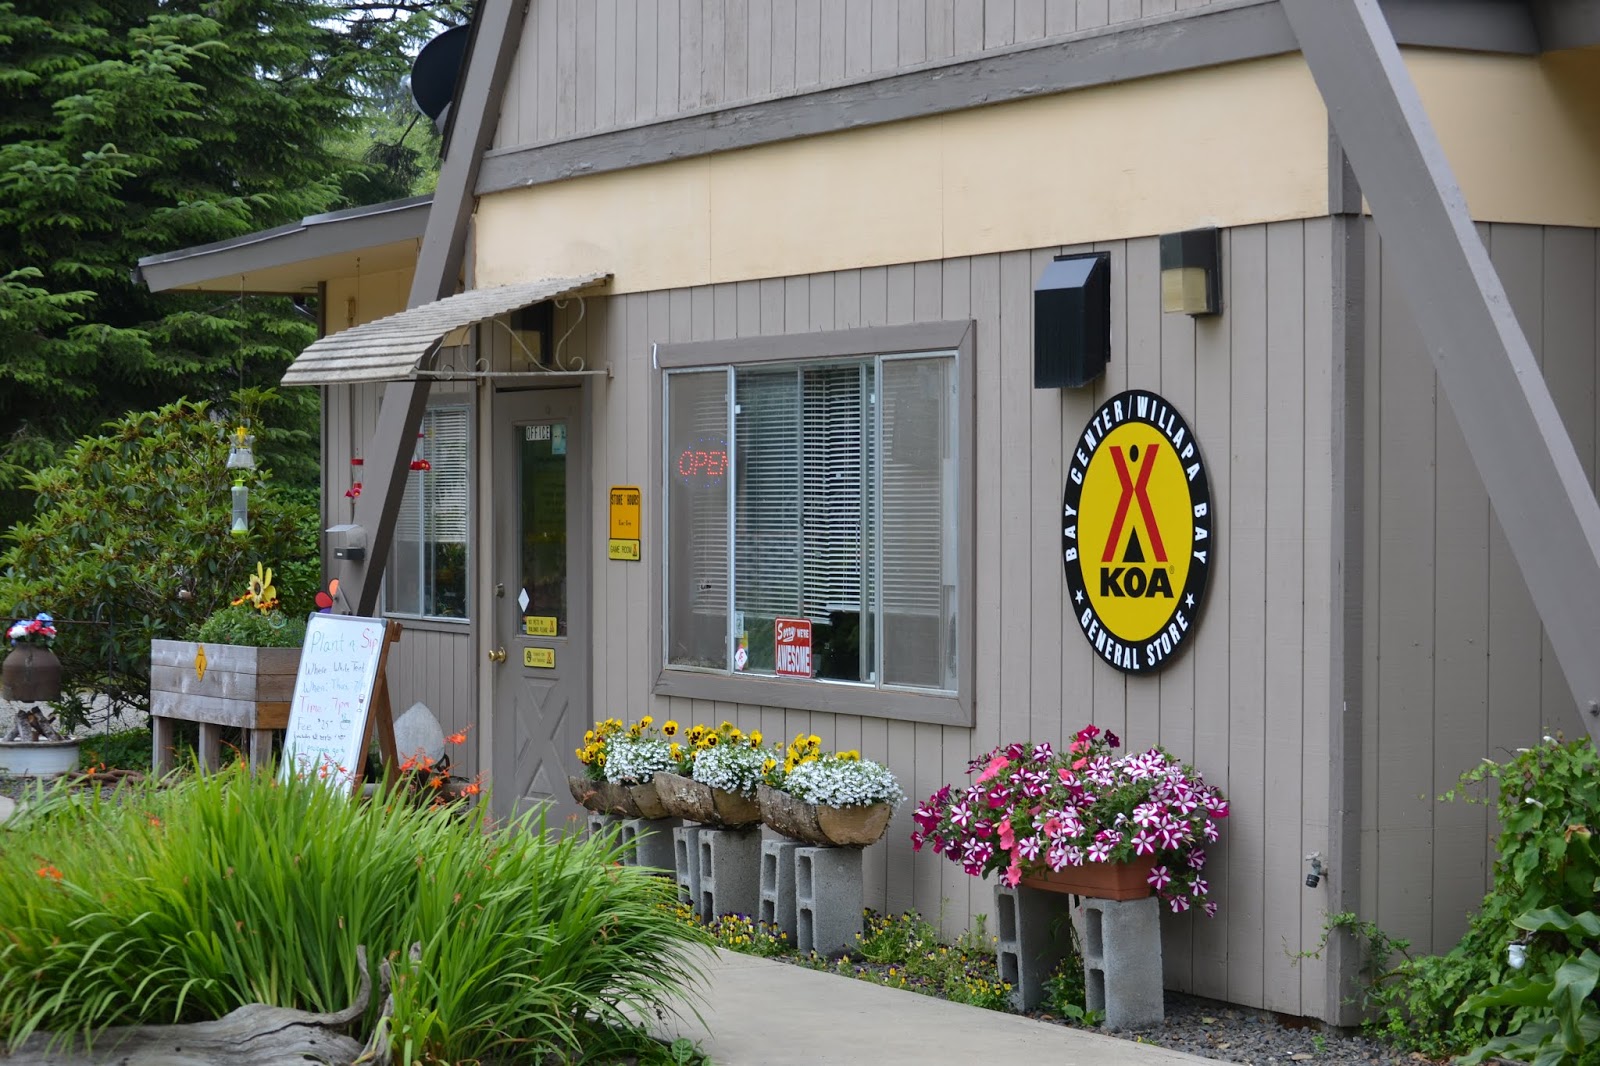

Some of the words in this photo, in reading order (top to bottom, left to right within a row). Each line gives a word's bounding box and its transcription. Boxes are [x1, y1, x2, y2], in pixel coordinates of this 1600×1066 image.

[527, 426, 550, 440] OFFICE
[1064, 504, 1077, 562] BAY
[1194, 502, 1208, 564] BAY
[1100, 567, 1174, 598] KOA
[311, 630, 345, 653] Plant
[361, 627, 378, 655] Sip
[1081, 607, 1139, 669] GENERAL
[1146, 610, 1188, 666] STORE
[777, 644, 810, 673] AWESOME
